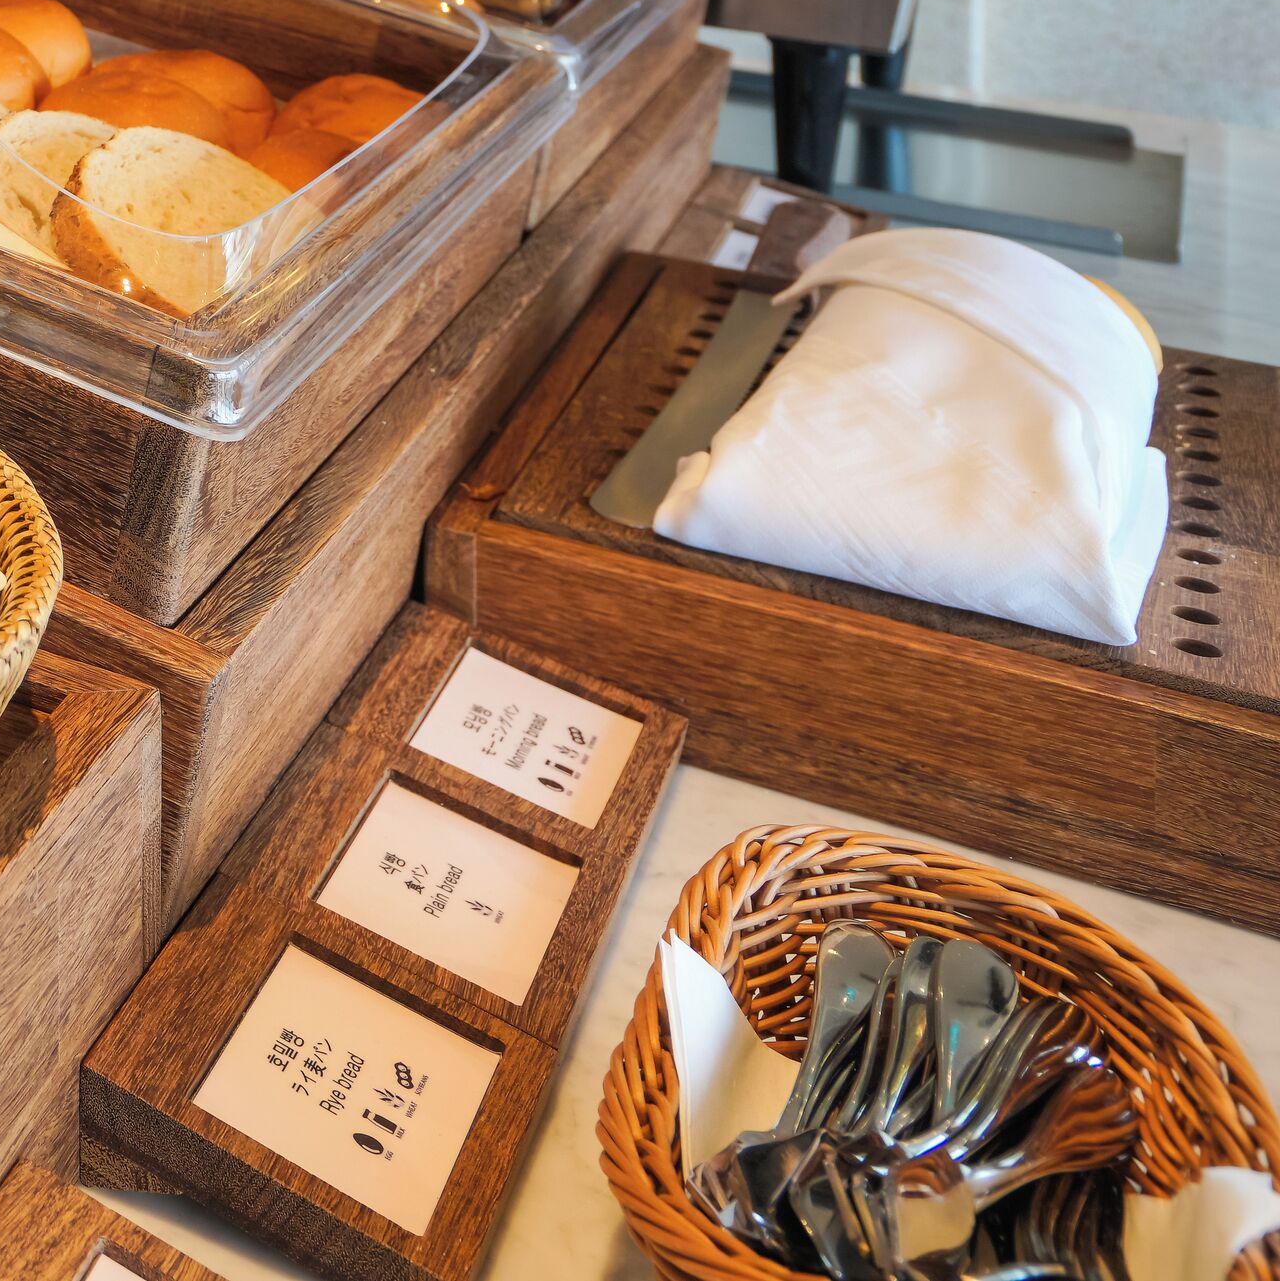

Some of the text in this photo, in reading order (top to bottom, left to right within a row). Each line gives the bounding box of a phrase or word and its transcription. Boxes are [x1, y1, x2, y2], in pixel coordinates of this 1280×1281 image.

[462, 703, 492, 733] 모닝빵
[481, 704, 519, 756] モーニングパン
[504, 712, 548, 771] Morning bread
[379, 852, 406, 875] 식빵
[405, 864, 428, 894] 食パン
[423, 863, 463, 918] Plain bread
[267, 1028, 304, 1072] 호밀빵
[292, 1038, 332, 1096] ライ麦パン
[319, 1051, 365, 1116] Rye bread
[384, 1150, 394, 1161] EGG
[396, 1127, 405, 1139] MILK
[405, 1101, 418, 1118] WHEAT
